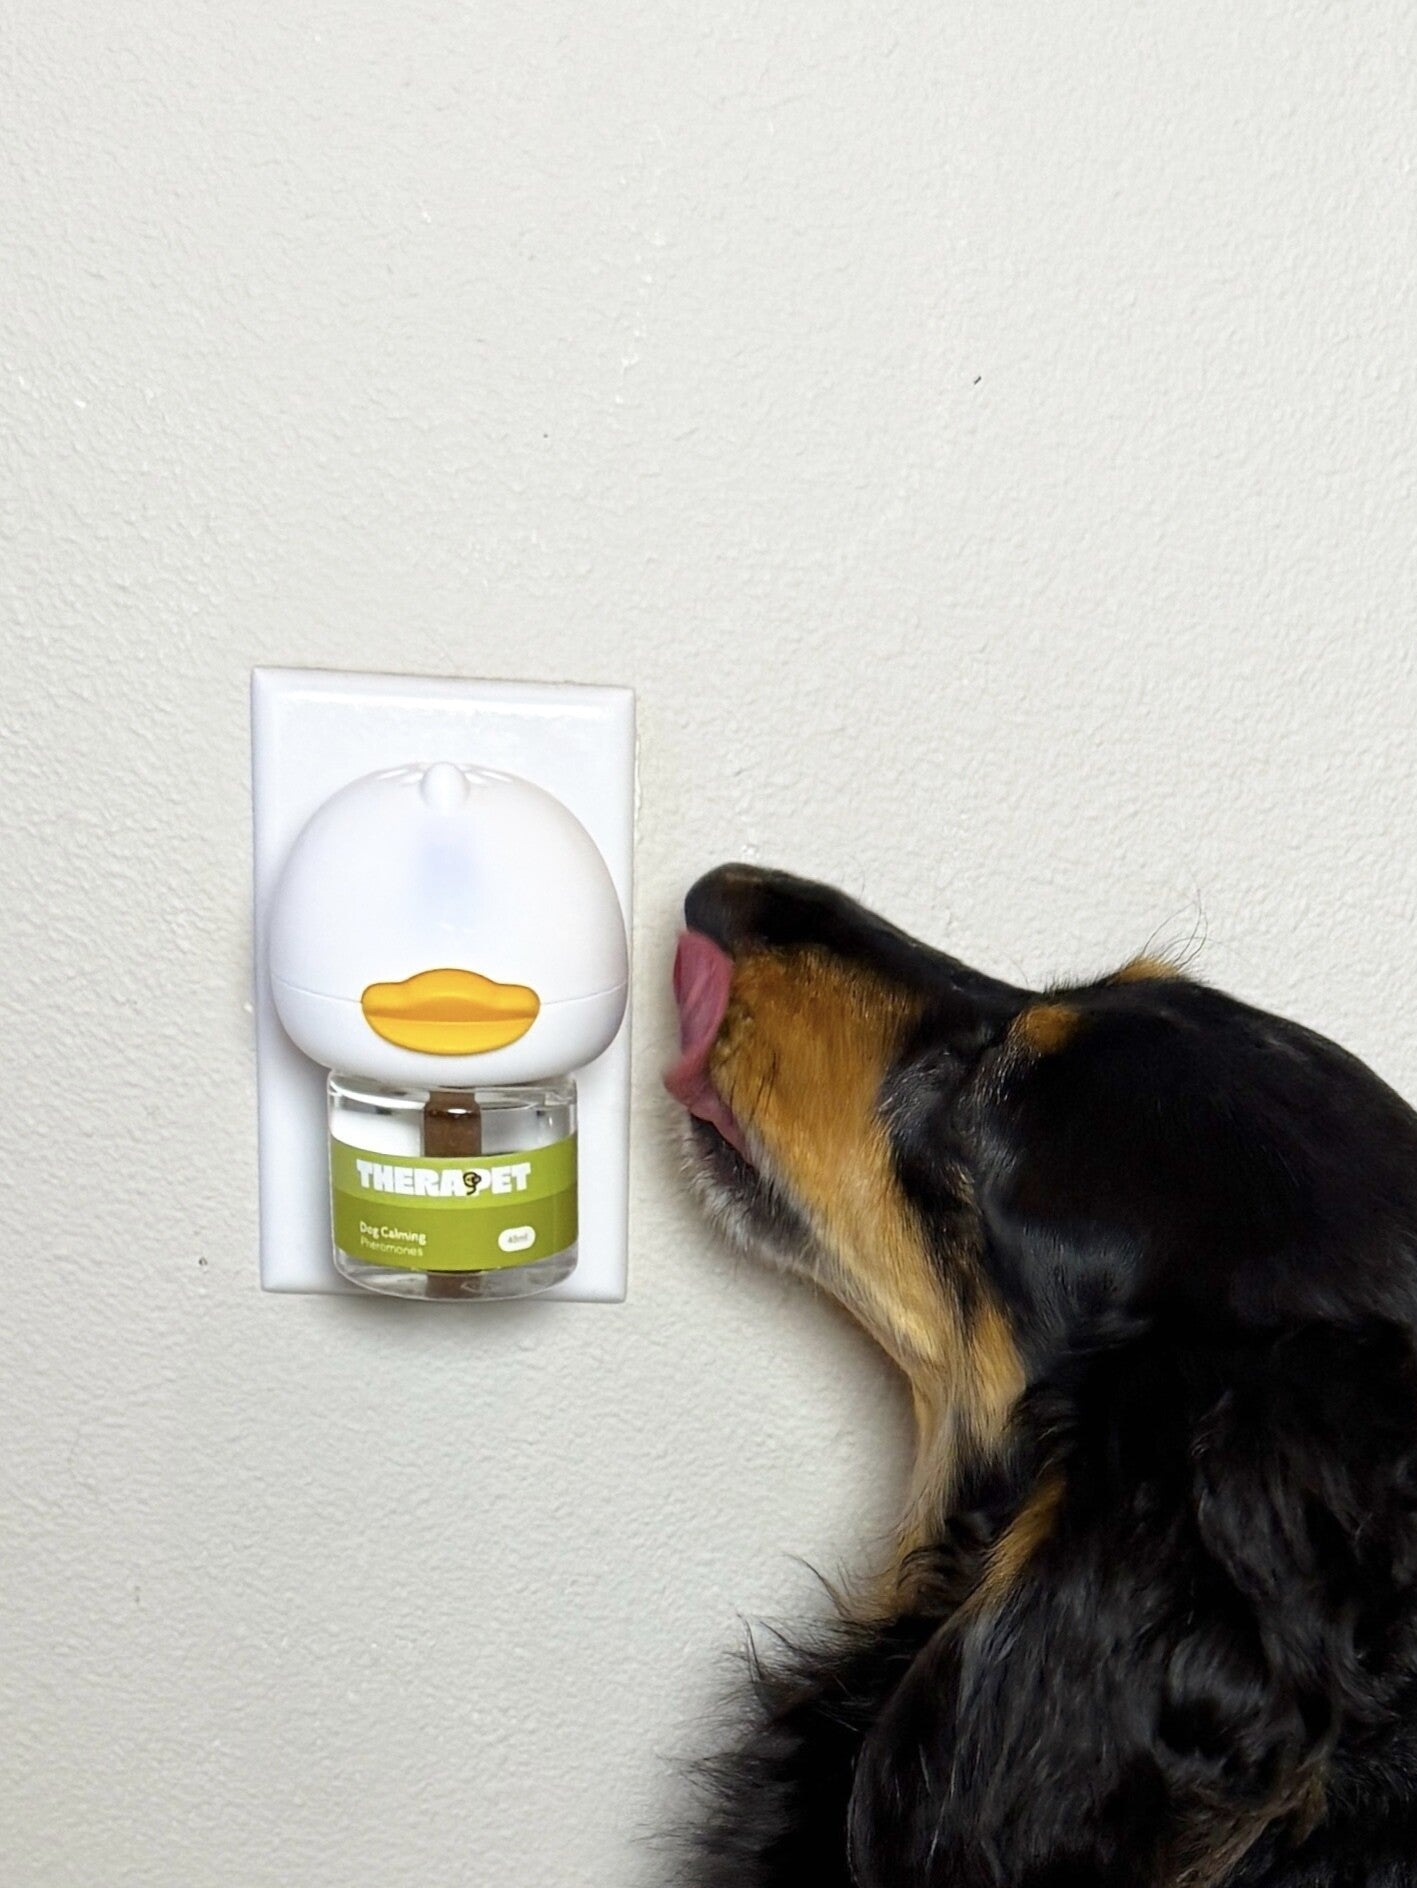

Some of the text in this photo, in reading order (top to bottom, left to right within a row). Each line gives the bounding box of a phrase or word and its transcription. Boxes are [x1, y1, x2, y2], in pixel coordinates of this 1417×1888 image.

[356, 1159, 532, 1197] THERAPET
[360, 1220, 427, 1246] Dog Calming
[360, 1235, 423, 1257] Pheromones
